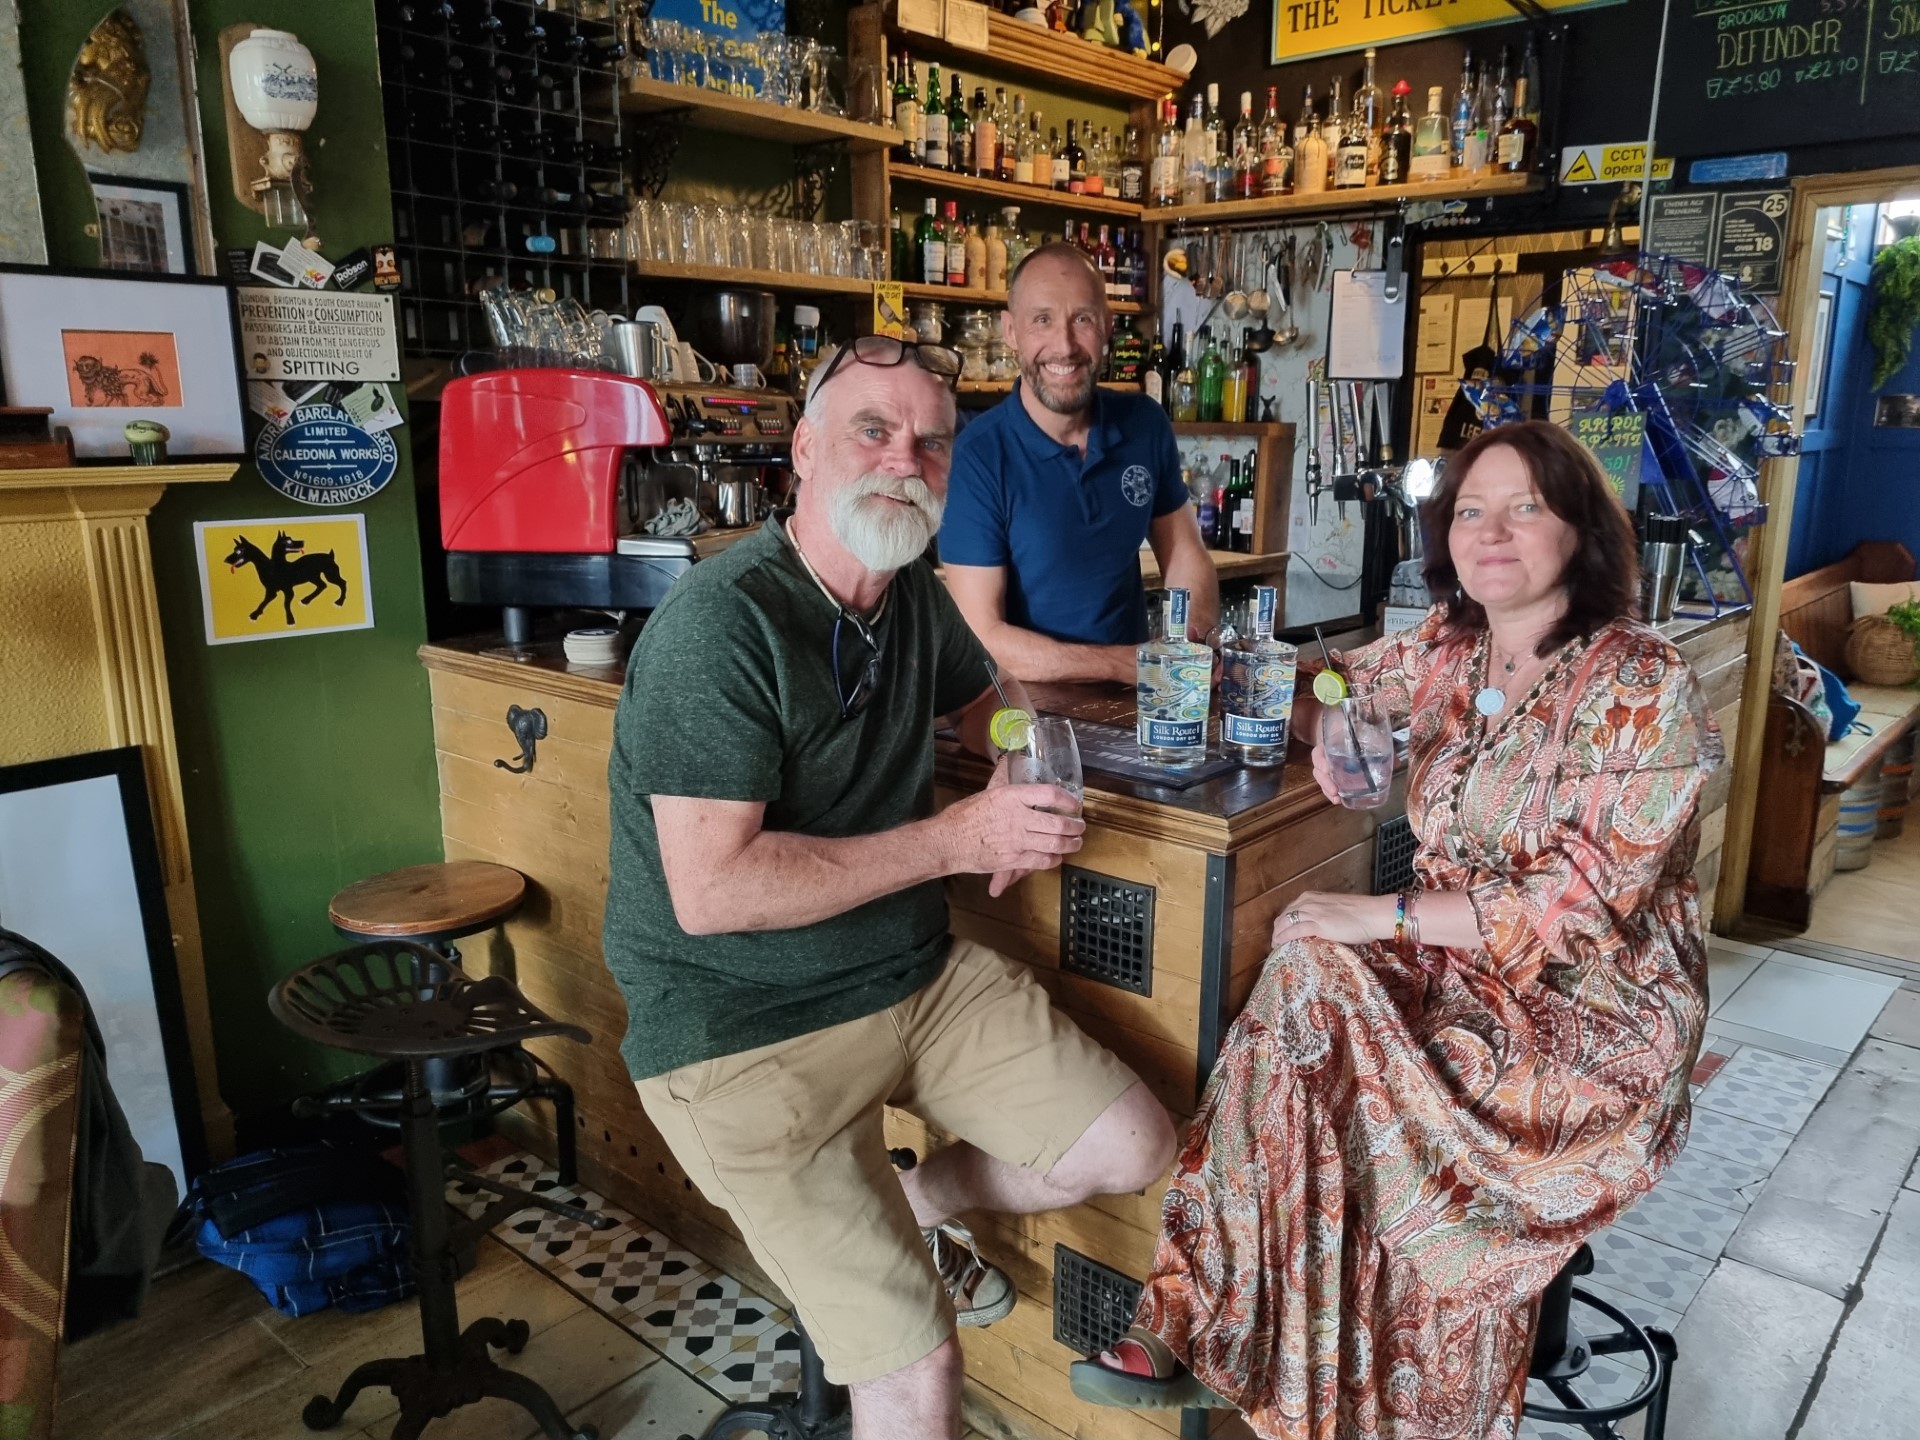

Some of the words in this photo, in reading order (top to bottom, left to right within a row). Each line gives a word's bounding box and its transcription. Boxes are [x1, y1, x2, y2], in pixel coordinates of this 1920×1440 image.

[699, 0, 738, 29] The
[1287, 0, 1339, 32] THE
[1363, 0, 1457, 19] TIC
[1717, 4, 1787, 30] BROOKLYN
[1716, 19, 1842, 69] DEFENDER
[680, 63, 697, 87] is
[1610, 148, 1647, 162] CCTV
[1603, 162, 1669, 177] operaon
[1765, 198, 1785, 213] 25
[1755, 236, 1774, 251] 18
[335, 260, 369, 283] Robson
[273, 295, 305, 306] BRIGHTON
[314, 298, 335, 307] SOUTH
[336, 298, 355, 308] COAST
[356, 299, 382, 309] RAILWAY
[241, 304, 306, 321] PREVENTION
[314, 308, 383, 323] CONSUMPTION
[244, 322, 292, 334] PASSENGERS
[293, 324, 307, 334] ARE
[309, 325, 346, 336] EARNESTLY
[347, 326, 386, 337] REQUESTED
[256, 335, 267, 345] TO
[268, 335, 300, 346] ABSTAIN
[301, 336, 322, 347] FROM
[323, 337, 337, 347] THE
[338, 337, 381, 348] DANGEROUS
[267, 347, 284, 357] AND
[285, 348, 341, 359] OBJECTIONABLE
[363, 349, 373, 359] OF
[282, 359, 360, 376] SPITTING
[1578, 415, 1642, 432] APEROL
[304, 426, 348, 437] LIMITED
[273, 449, 337, 461] CALEDONIA
[340, 448, 380, 460] WORKS
[282, 480, 376, 503] KILMARNOCK
[1153, 724, 1170, 735] Silk
[1236, 721, 1253, 732] Silk
